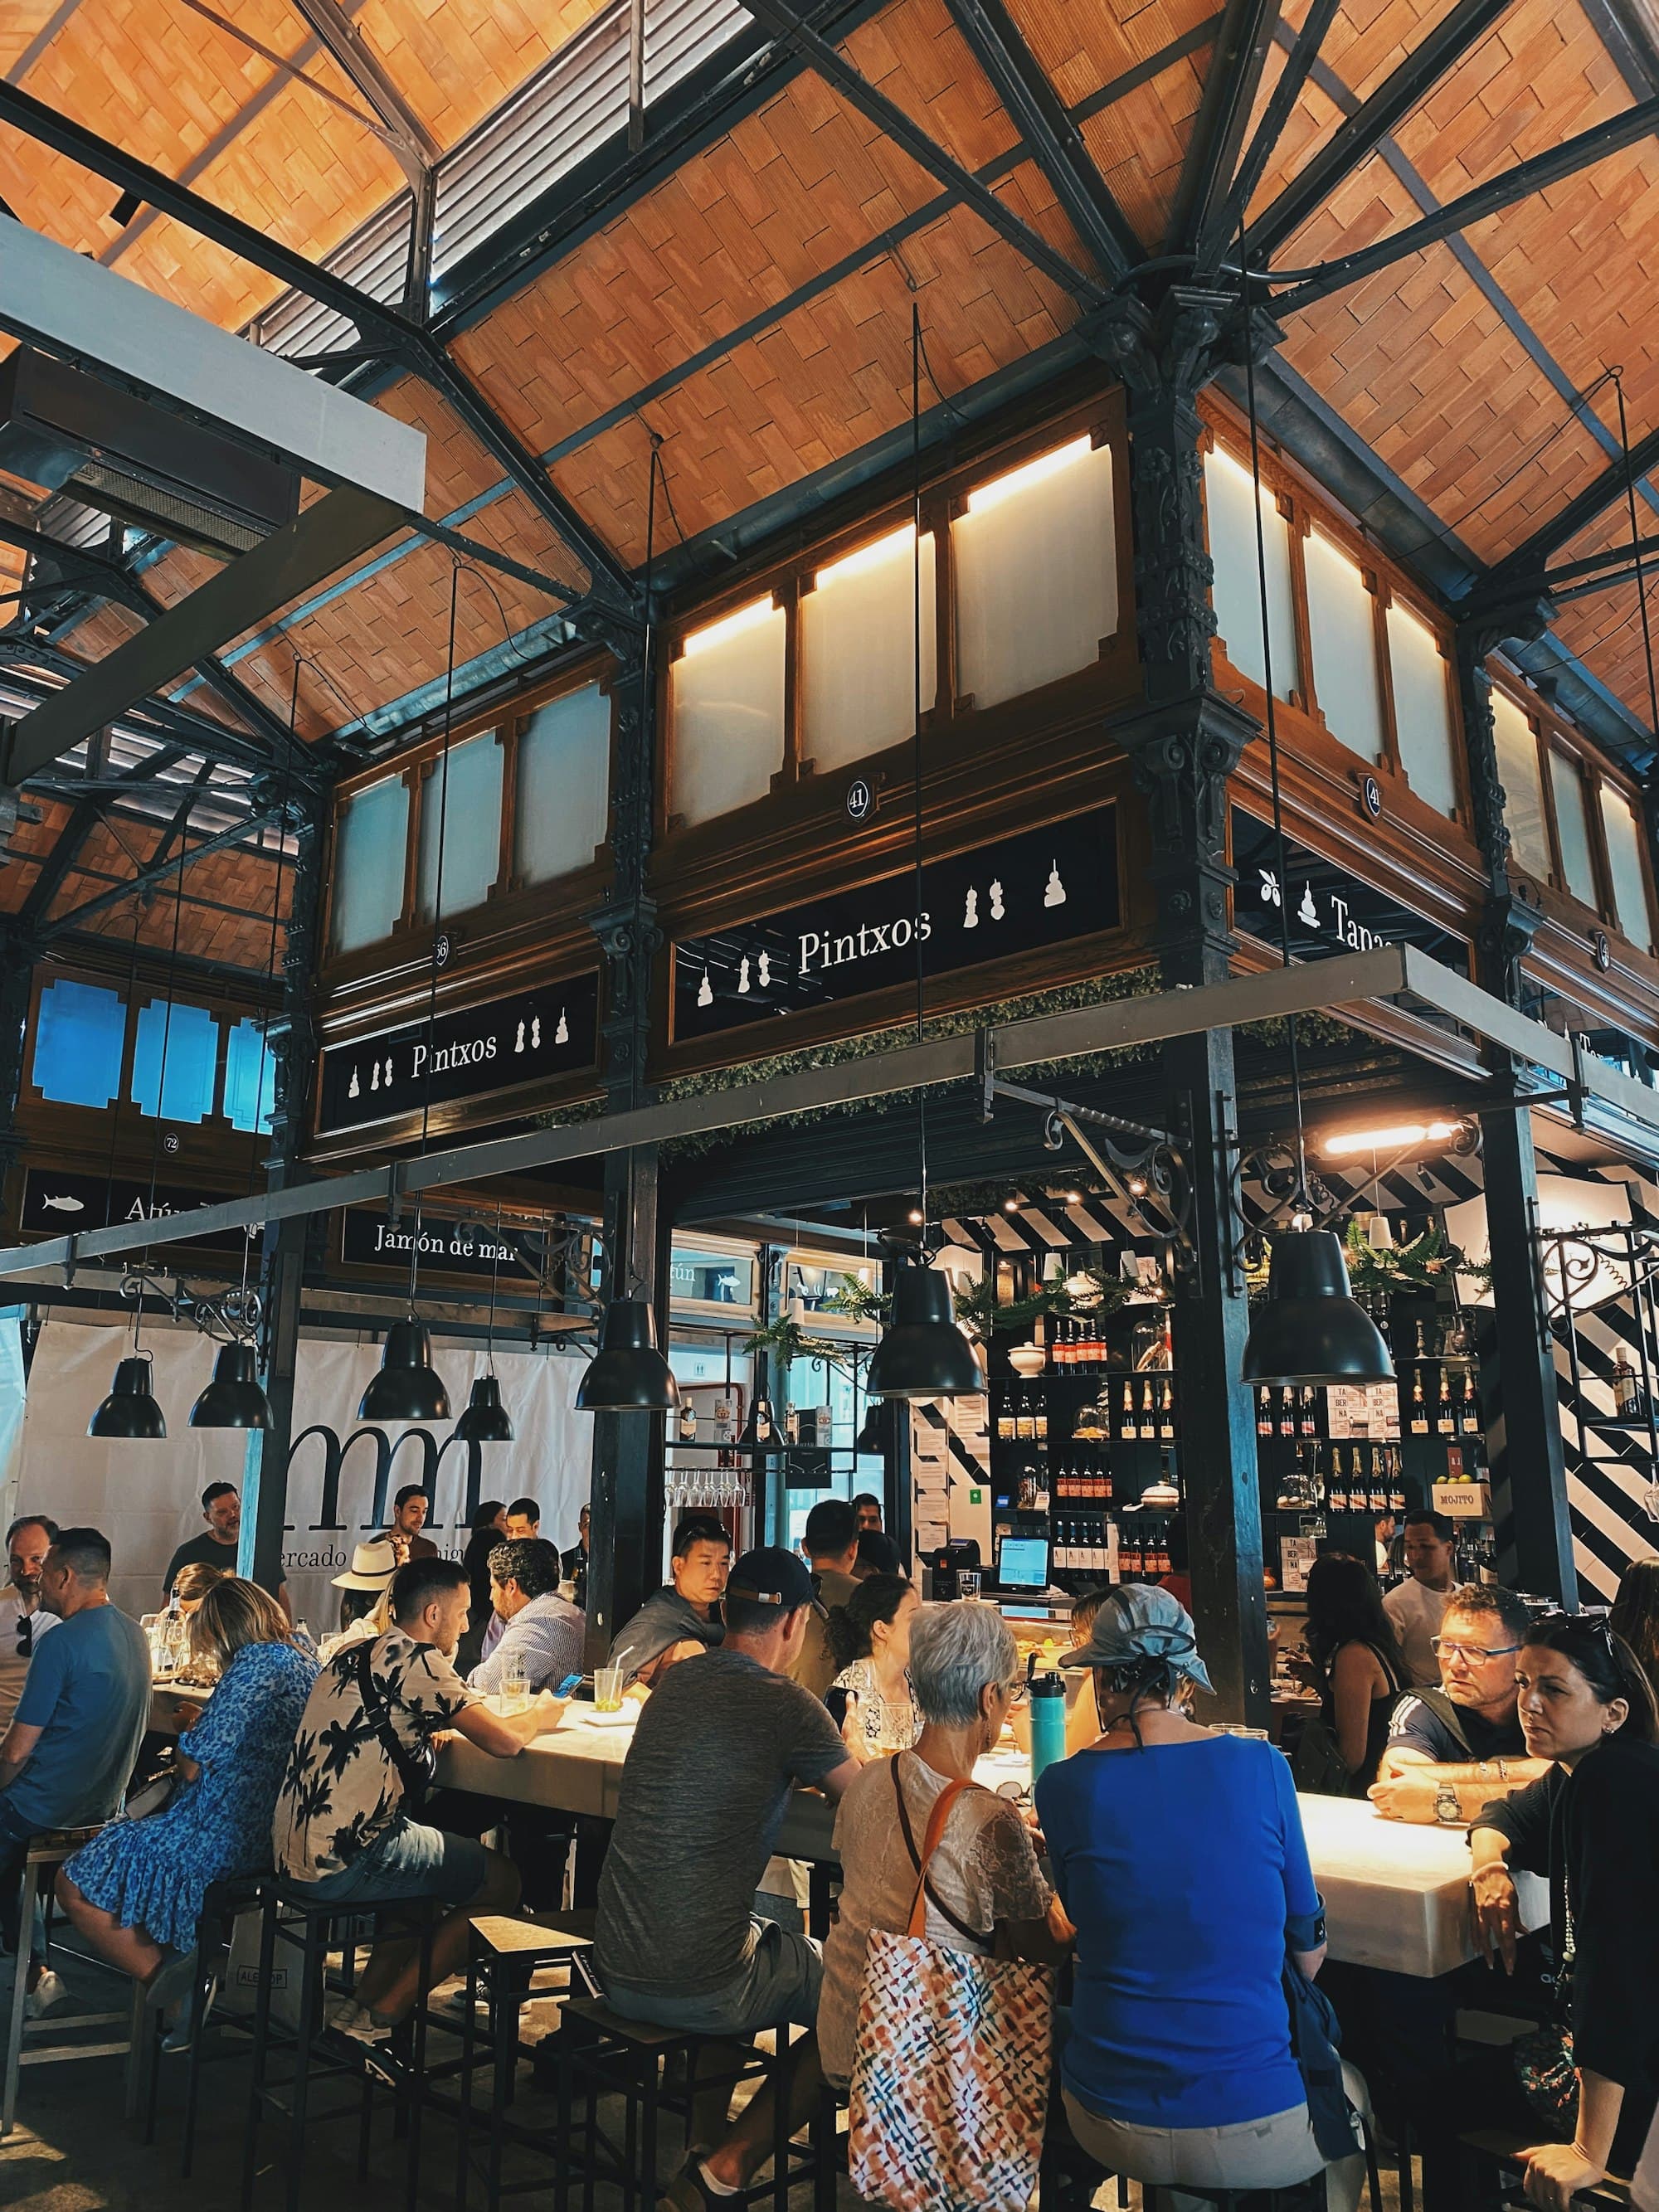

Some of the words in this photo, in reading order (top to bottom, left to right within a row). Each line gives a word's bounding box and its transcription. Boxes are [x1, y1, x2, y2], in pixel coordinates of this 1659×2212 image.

[849, 788, 864, 809] 41
[1370, 786, 1380, 806] 41
[1331, 895, 1393, 952] Tap
[798, 912, 932, 975] Pintxos
[411, 1036, 498, 1078] Pintxos
[166, 1137, 178, 1149] 72
[124, 1196, 187, 1221] Atú
[374, 1224, 445, 1253] Jamón
[450, 1239, 474, 1257] de
[1440, 1495, 1474, 1505] MOJITO
[280, 1544, 347, 1568] ercado
[241, 1971, 283, 1985] ALEOP
